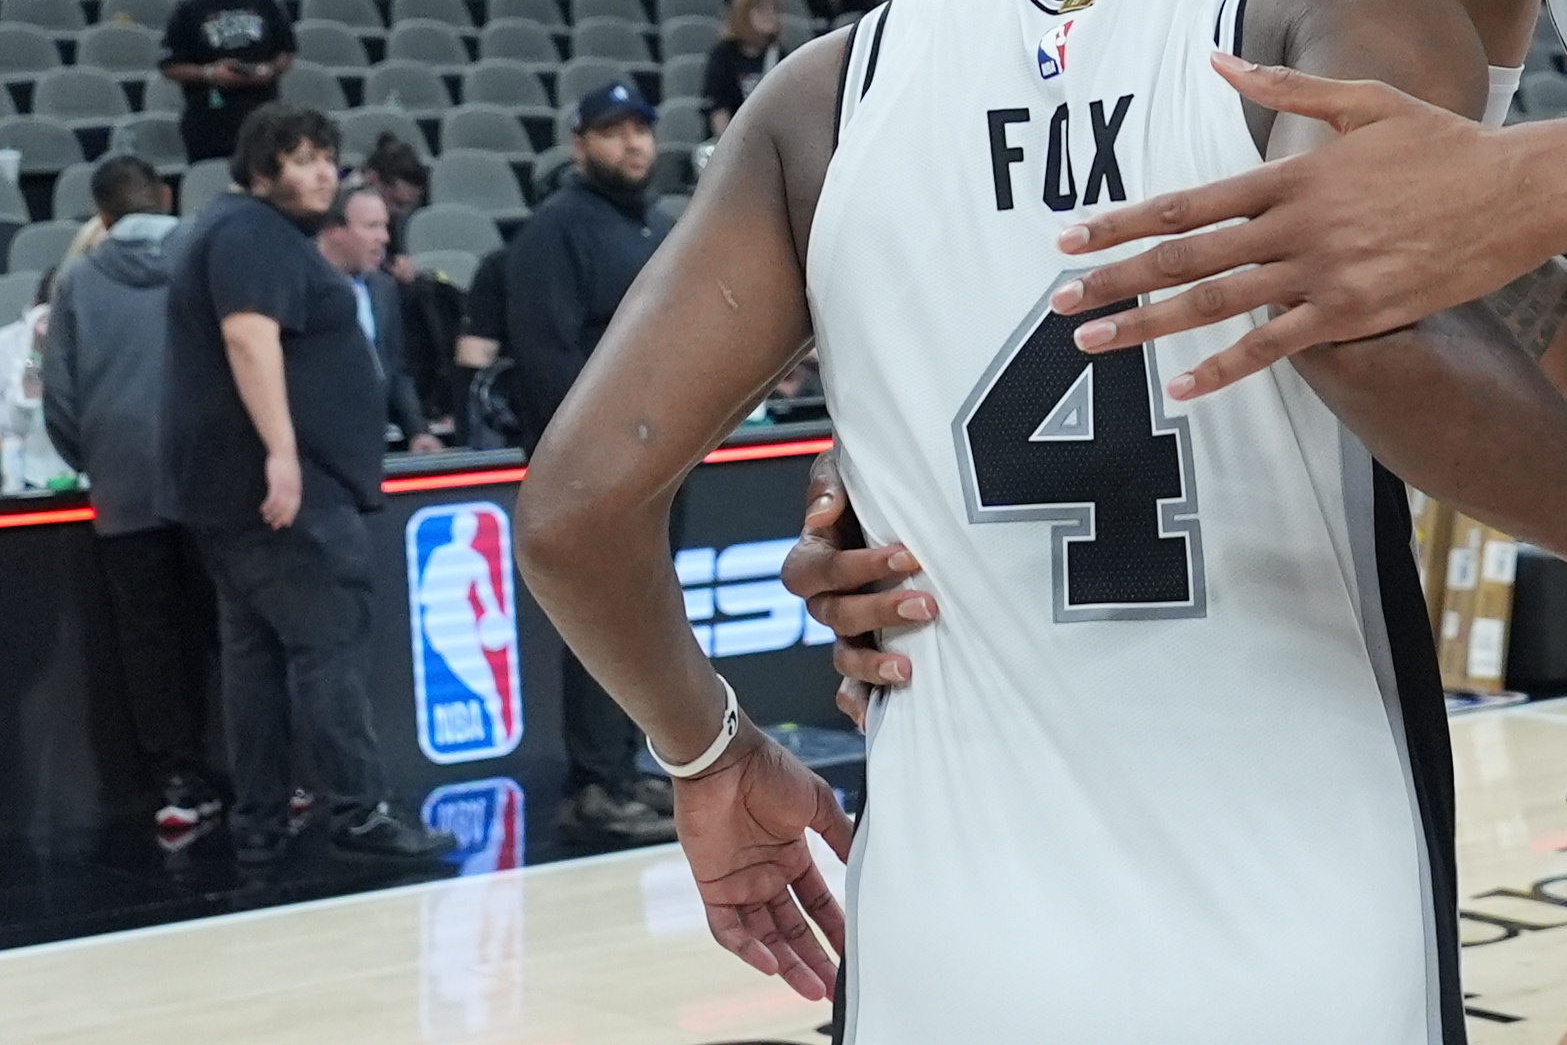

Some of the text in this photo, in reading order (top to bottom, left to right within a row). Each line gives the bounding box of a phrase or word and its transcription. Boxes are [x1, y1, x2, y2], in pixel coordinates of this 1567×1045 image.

[987, 94, 1134, 212] FOX
[951, 268, 1207, 623] 4
[433, 699, 486, 746] NBA
